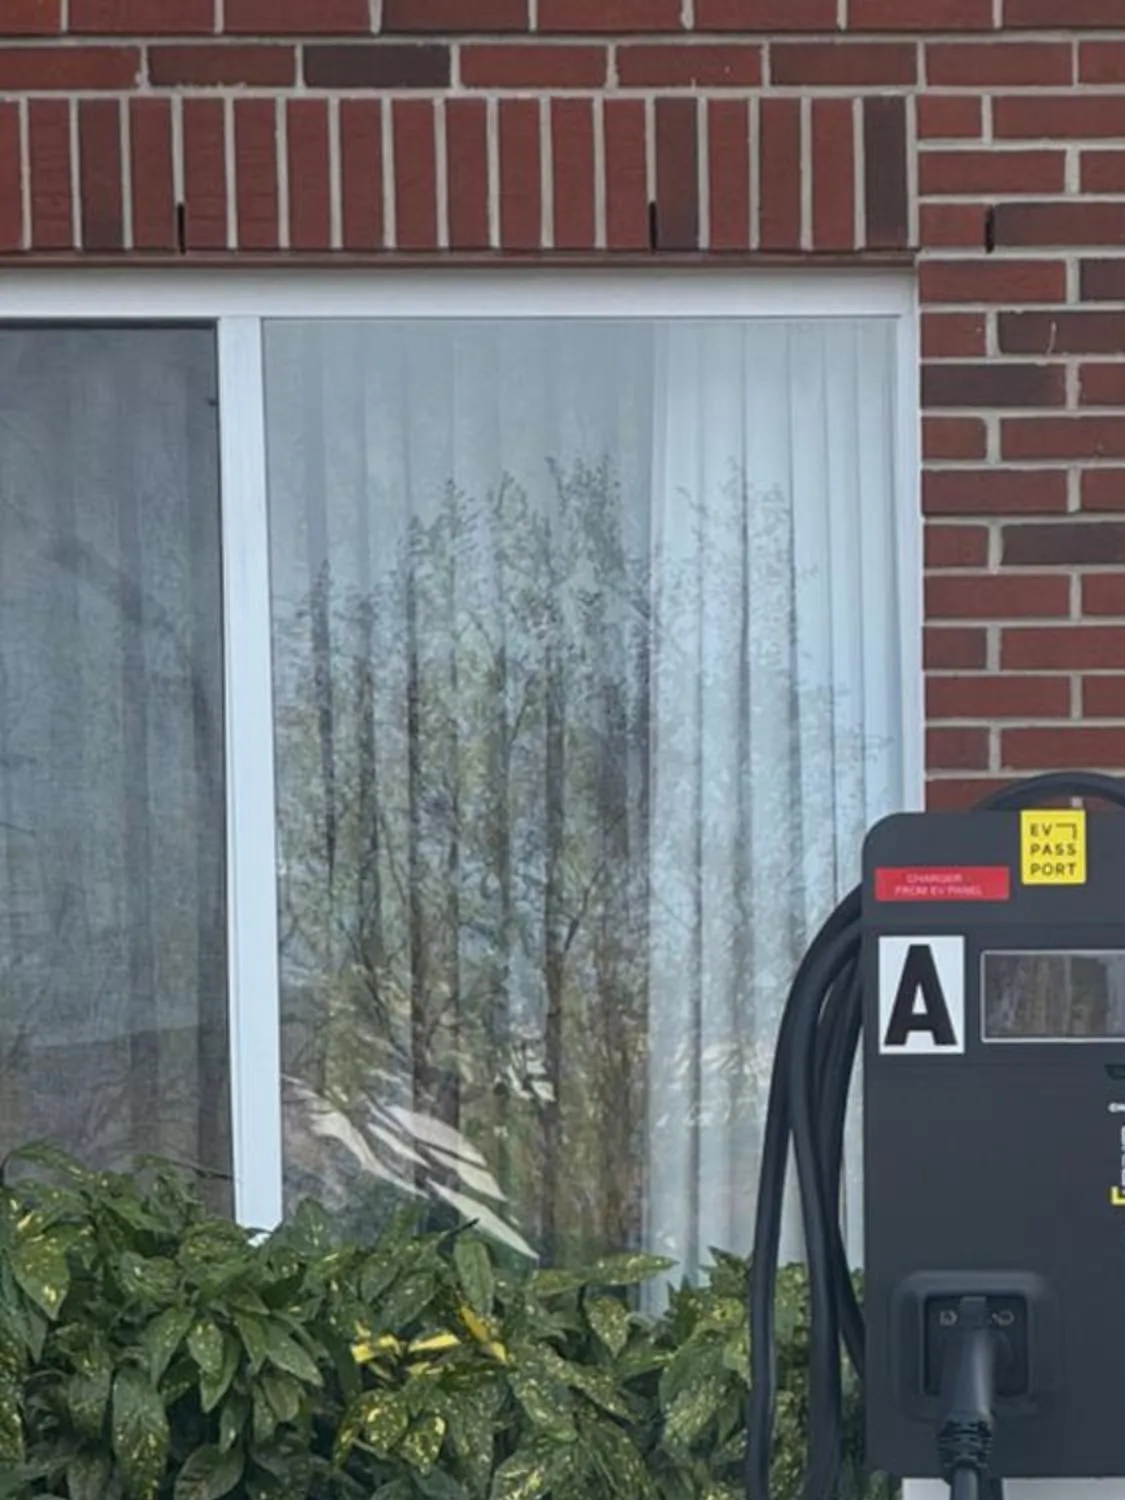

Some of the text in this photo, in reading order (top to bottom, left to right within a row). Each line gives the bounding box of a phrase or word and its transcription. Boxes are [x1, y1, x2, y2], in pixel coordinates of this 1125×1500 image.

[1030, 823, 1053, 837] EV
[1030, 843, 1077, 856] PASS
[1030, 862, 1077, 877] PORT
[883, 943, 959, 1047] A
